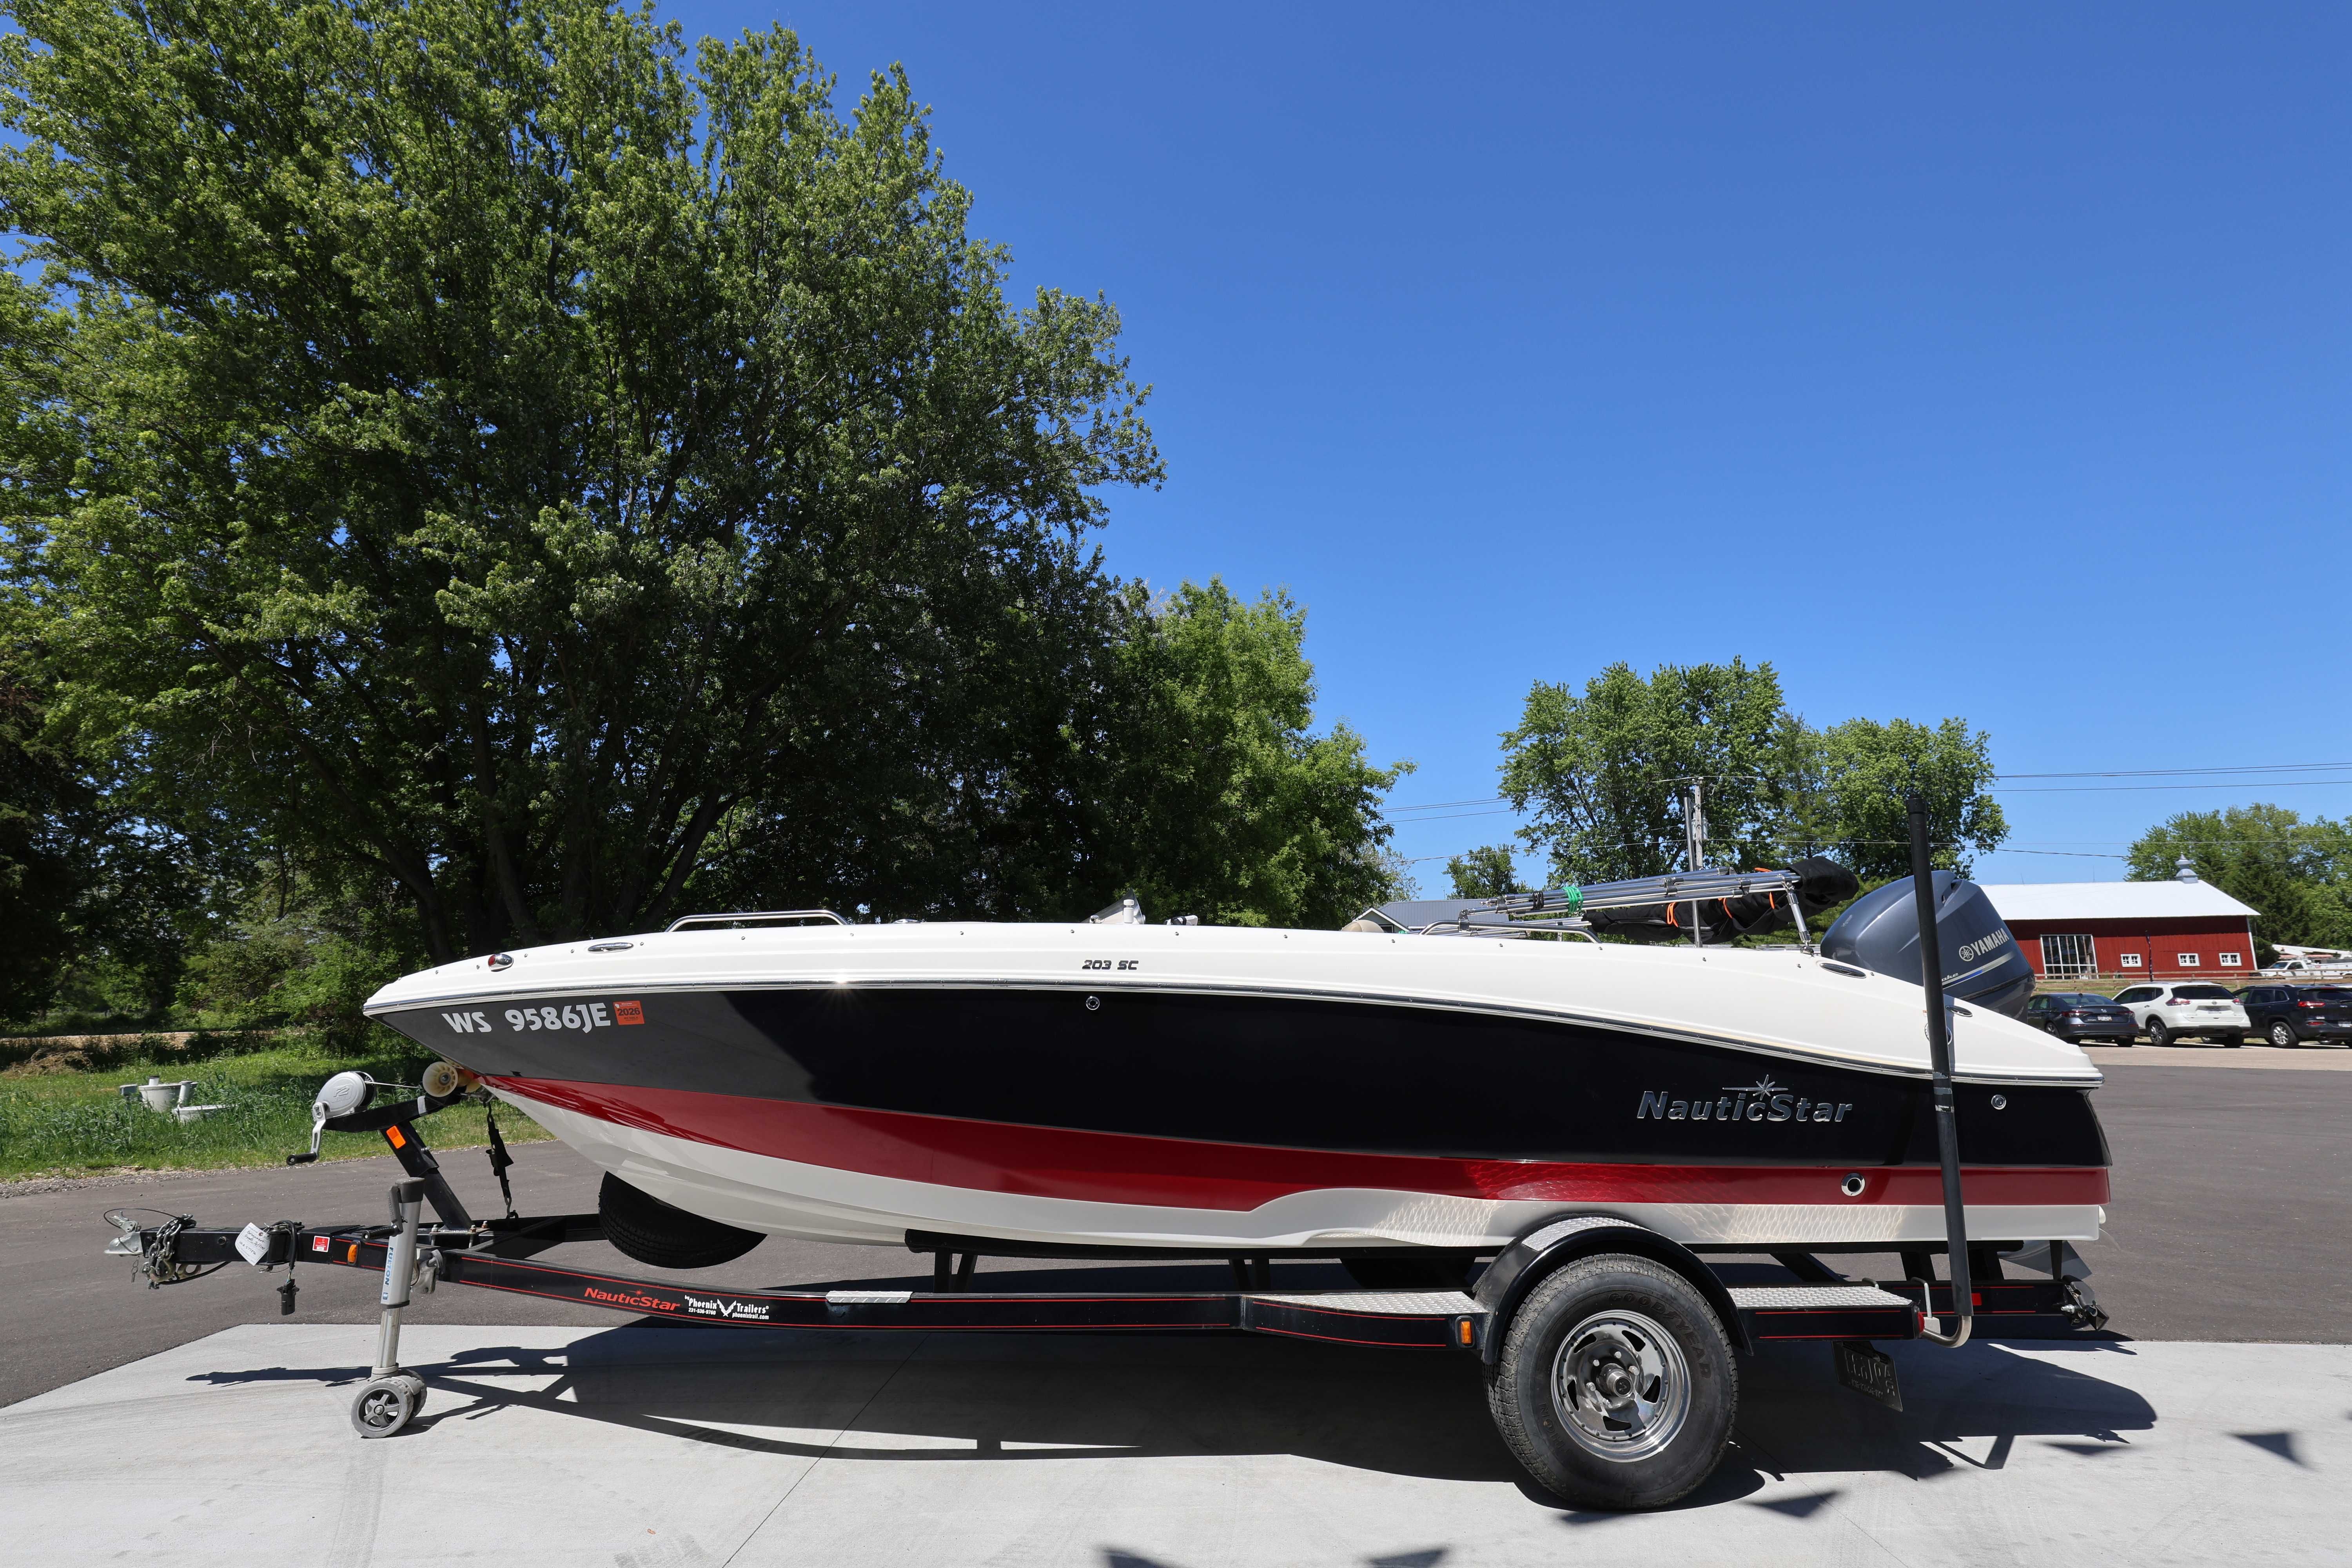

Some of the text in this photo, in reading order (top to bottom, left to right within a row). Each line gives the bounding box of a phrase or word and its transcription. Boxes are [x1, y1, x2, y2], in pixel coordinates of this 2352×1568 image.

[1970, 928, 2009, 956] YAMAHA
[1082, 960, 1139, 970] 203 SC
[441, 1002, 611, 1033] WS 9586JE
[617, 1007, 641, 1016] 2026
[1637, 1091, 1853, 1122] NauticStar
[385, 1247, 394, 1286] FULTON
[584, 1287, 681, 1311] NauticStar
[688, 1298, 717, 1309] Phoenix
[1608, 1293, 1712, 1379] GOODYEAR
